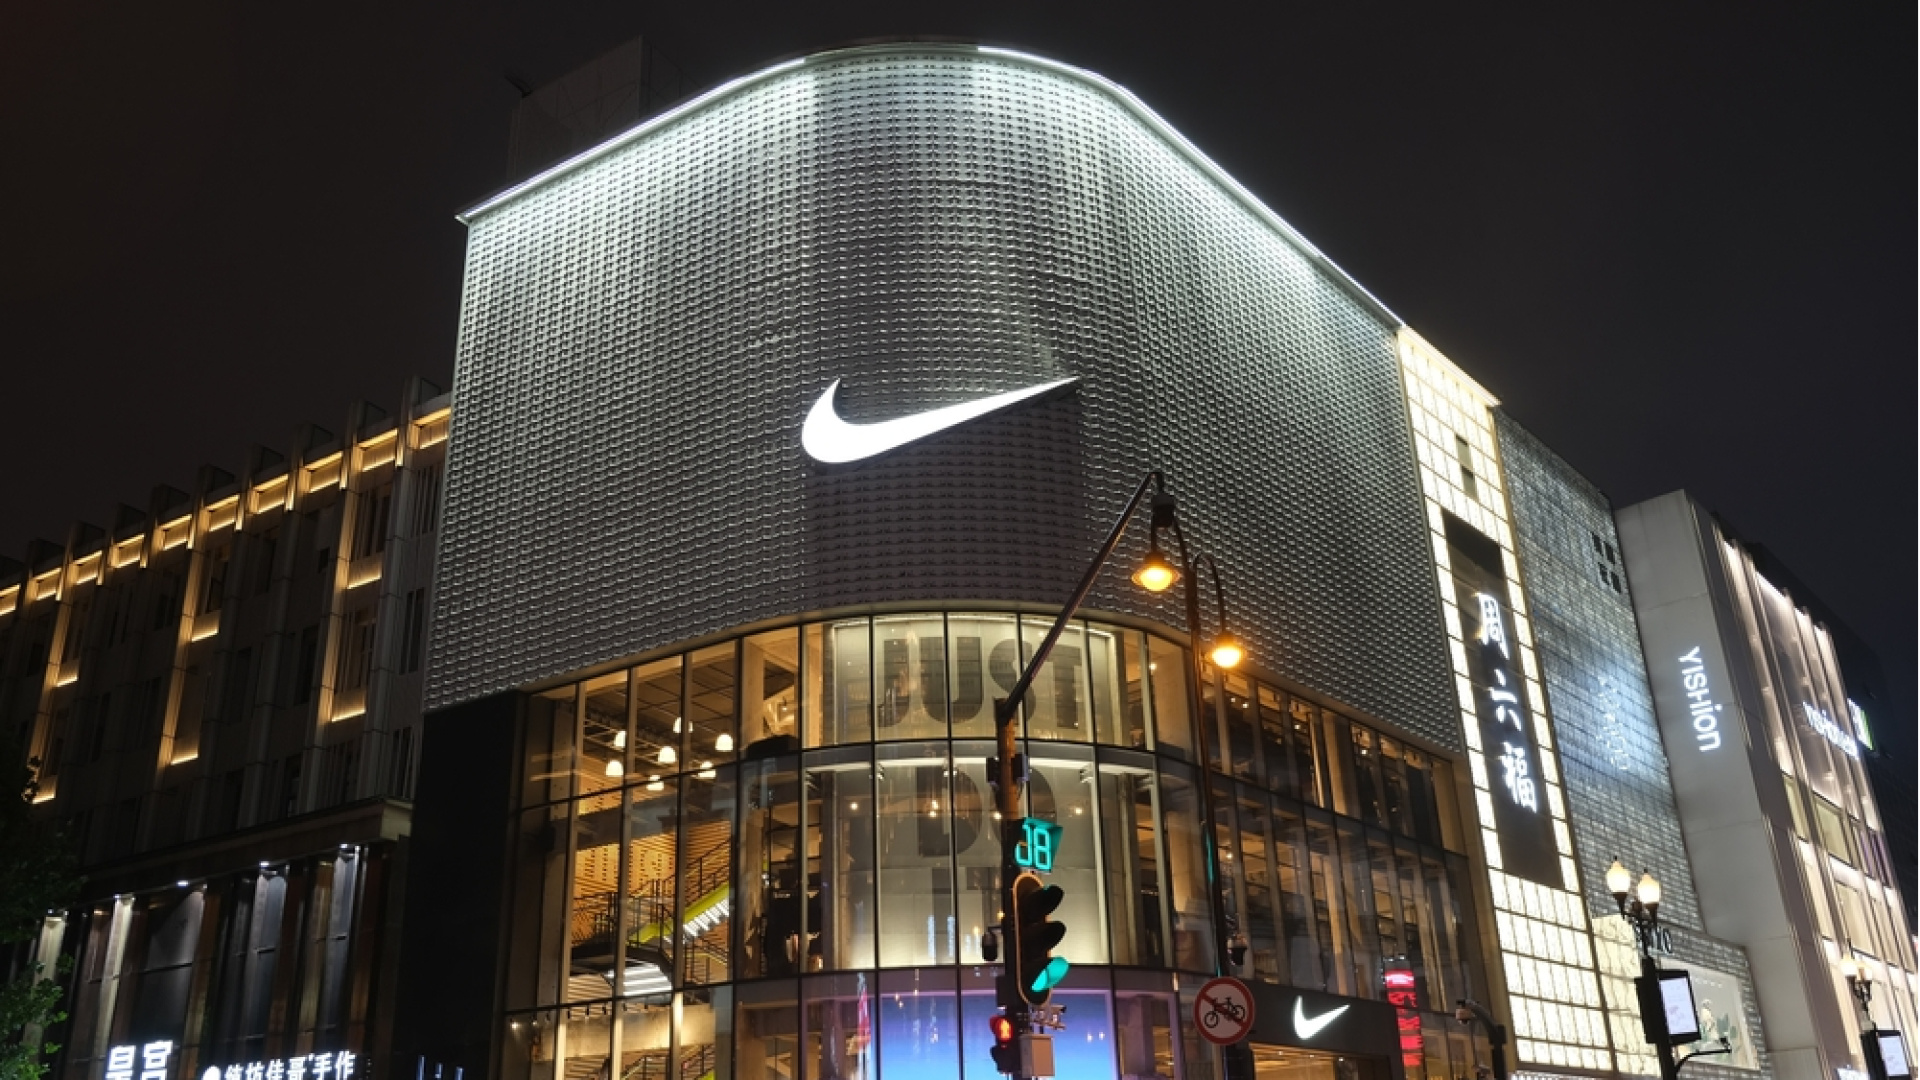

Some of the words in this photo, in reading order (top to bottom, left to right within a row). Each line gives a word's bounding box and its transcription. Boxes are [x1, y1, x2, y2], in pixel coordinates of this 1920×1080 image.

[867, 636, 1082, 730] JUST
[1478, 592, 1538, 814] 周六福
